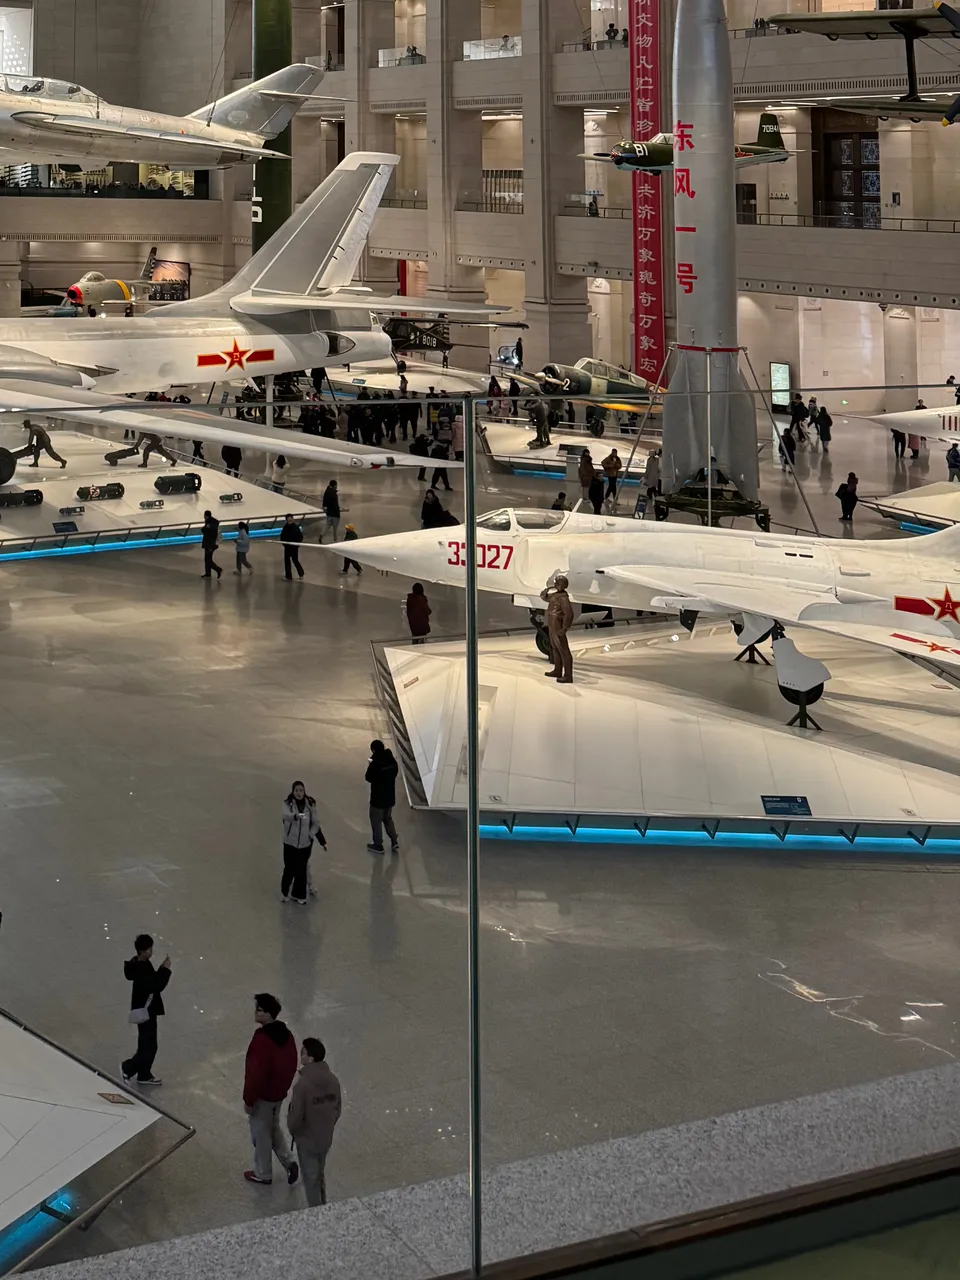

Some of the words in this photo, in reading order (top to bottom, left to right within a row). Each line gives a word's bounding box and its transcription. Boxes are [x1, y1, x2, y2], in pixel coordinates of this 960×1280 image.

[673, 120, 698, 294] 东风一号
[422, 335, 437, 347] 8018
[563, 378, 571, 391] 2
